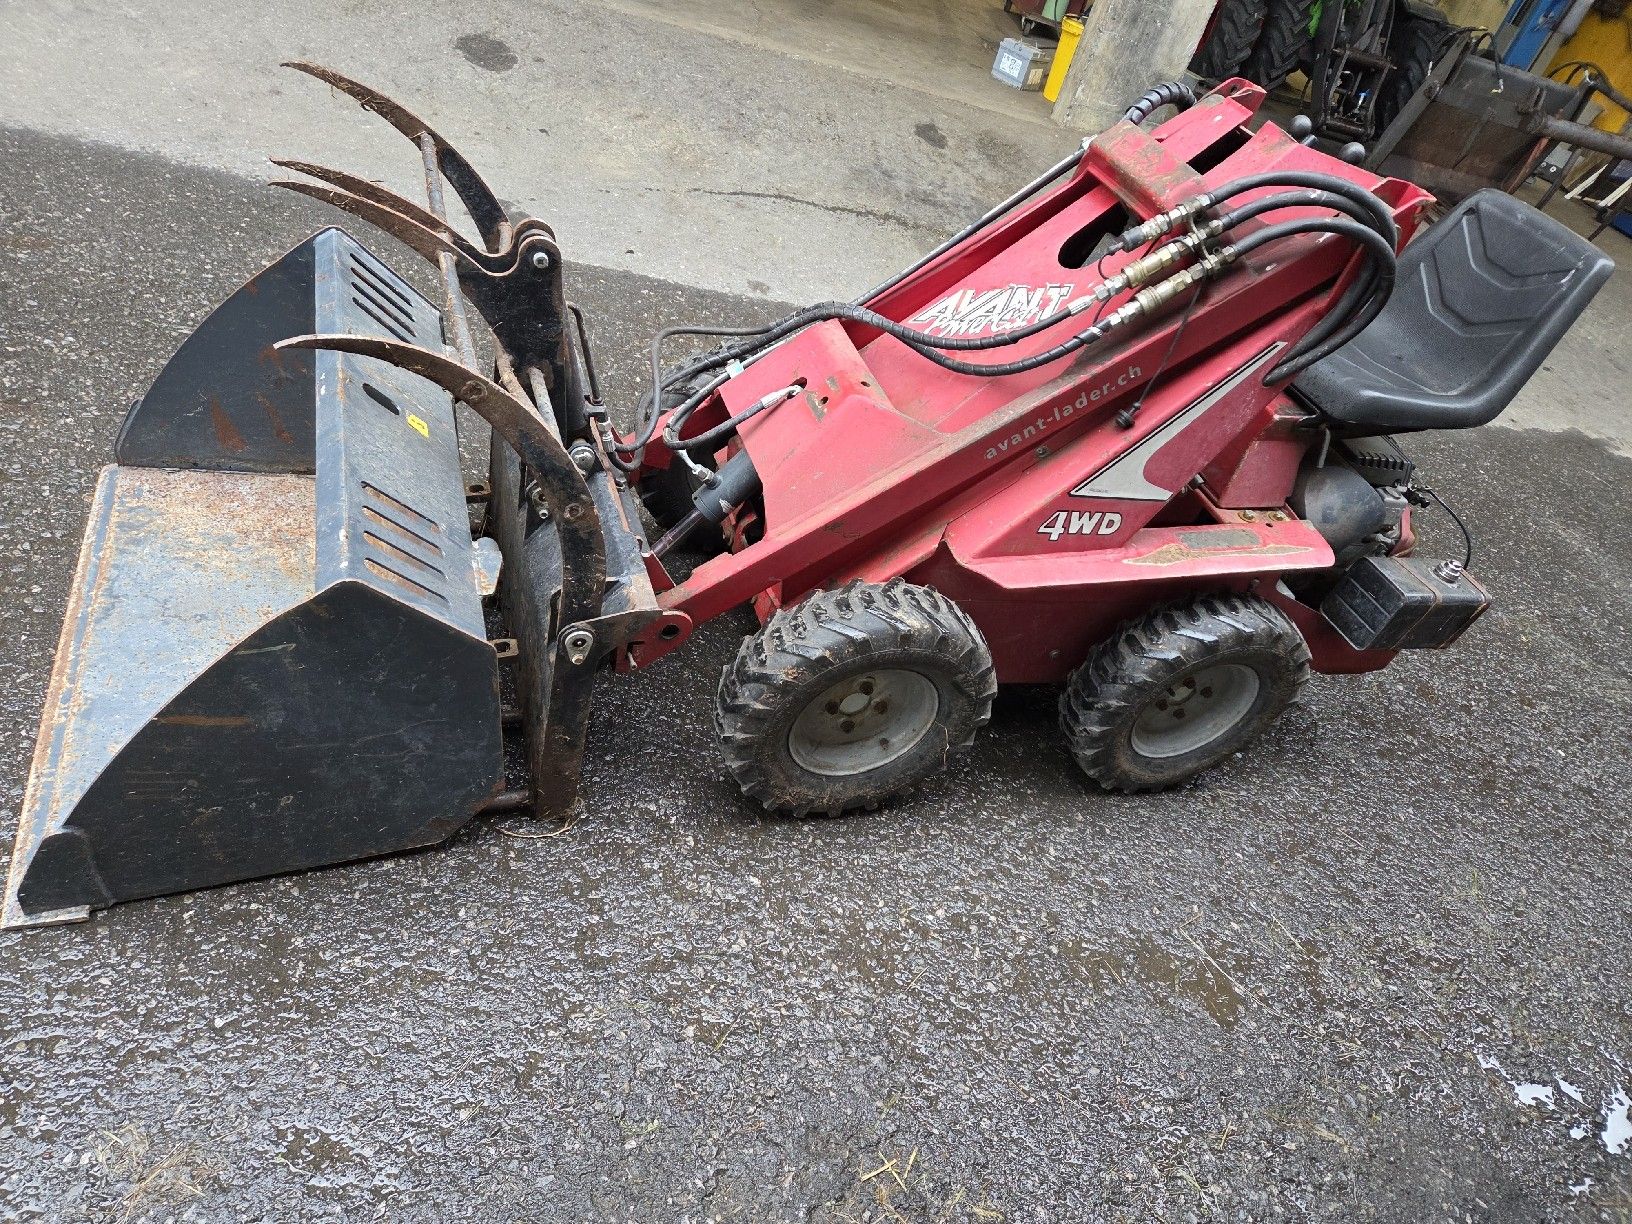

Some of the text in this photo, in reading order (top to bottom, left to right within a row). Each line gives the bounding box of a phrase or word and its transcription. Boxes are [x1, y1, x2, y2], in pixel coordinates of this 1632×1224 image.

[907, 283, 1074, 324] AVANT
[985, 366, 1142, 460] avant-lader.ch
[1037, 510, 1123, 542] 4WD
